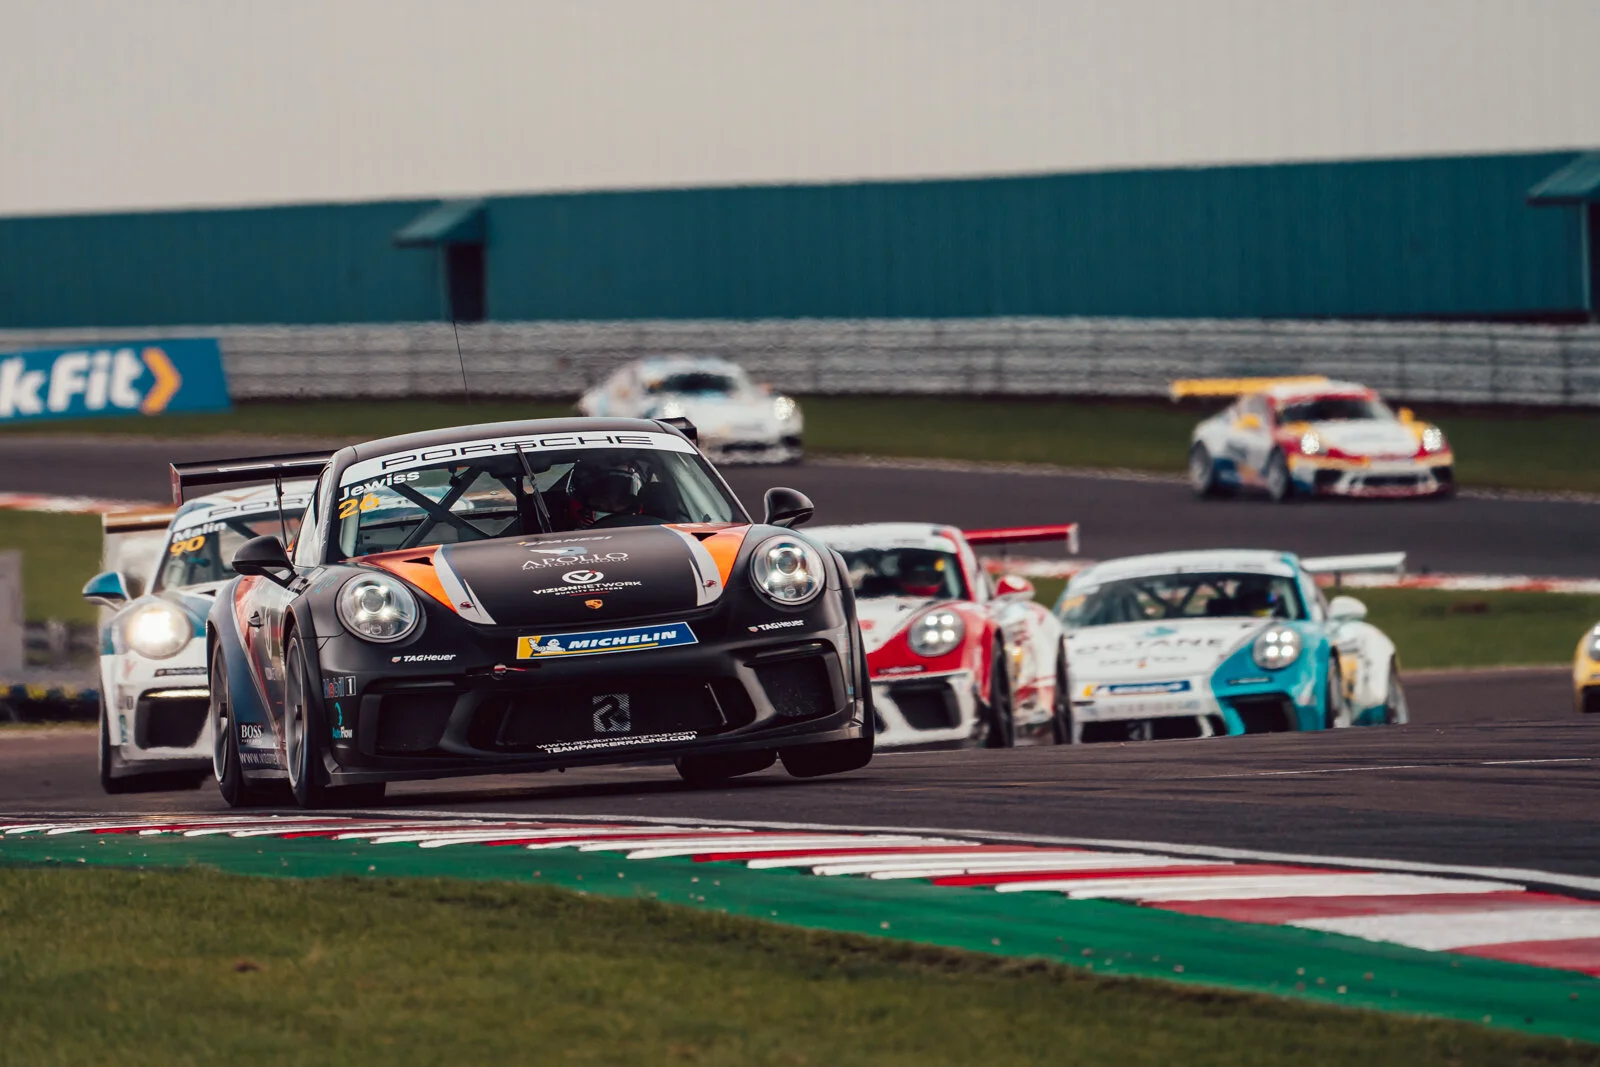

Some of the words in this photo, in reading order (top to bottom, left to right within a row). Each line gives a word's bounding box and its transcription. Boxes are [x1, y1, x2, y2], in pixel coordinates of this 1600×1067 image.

[381, 435, 654, 470] PORSCHE
[339, 471, 420, 501] Jewiss
[338, 492, 380, 519] 26
[172, 522, 227, 543] Malin
[170, 535, 206, 556] 90
[522, 552, 629, 567] APOLLO
[568, 630, 677, 649] MICHELIN
[241, 724, 262, 739] BOSS
[545, 735, 696, 754] TEAMPARKERRACING.COM
